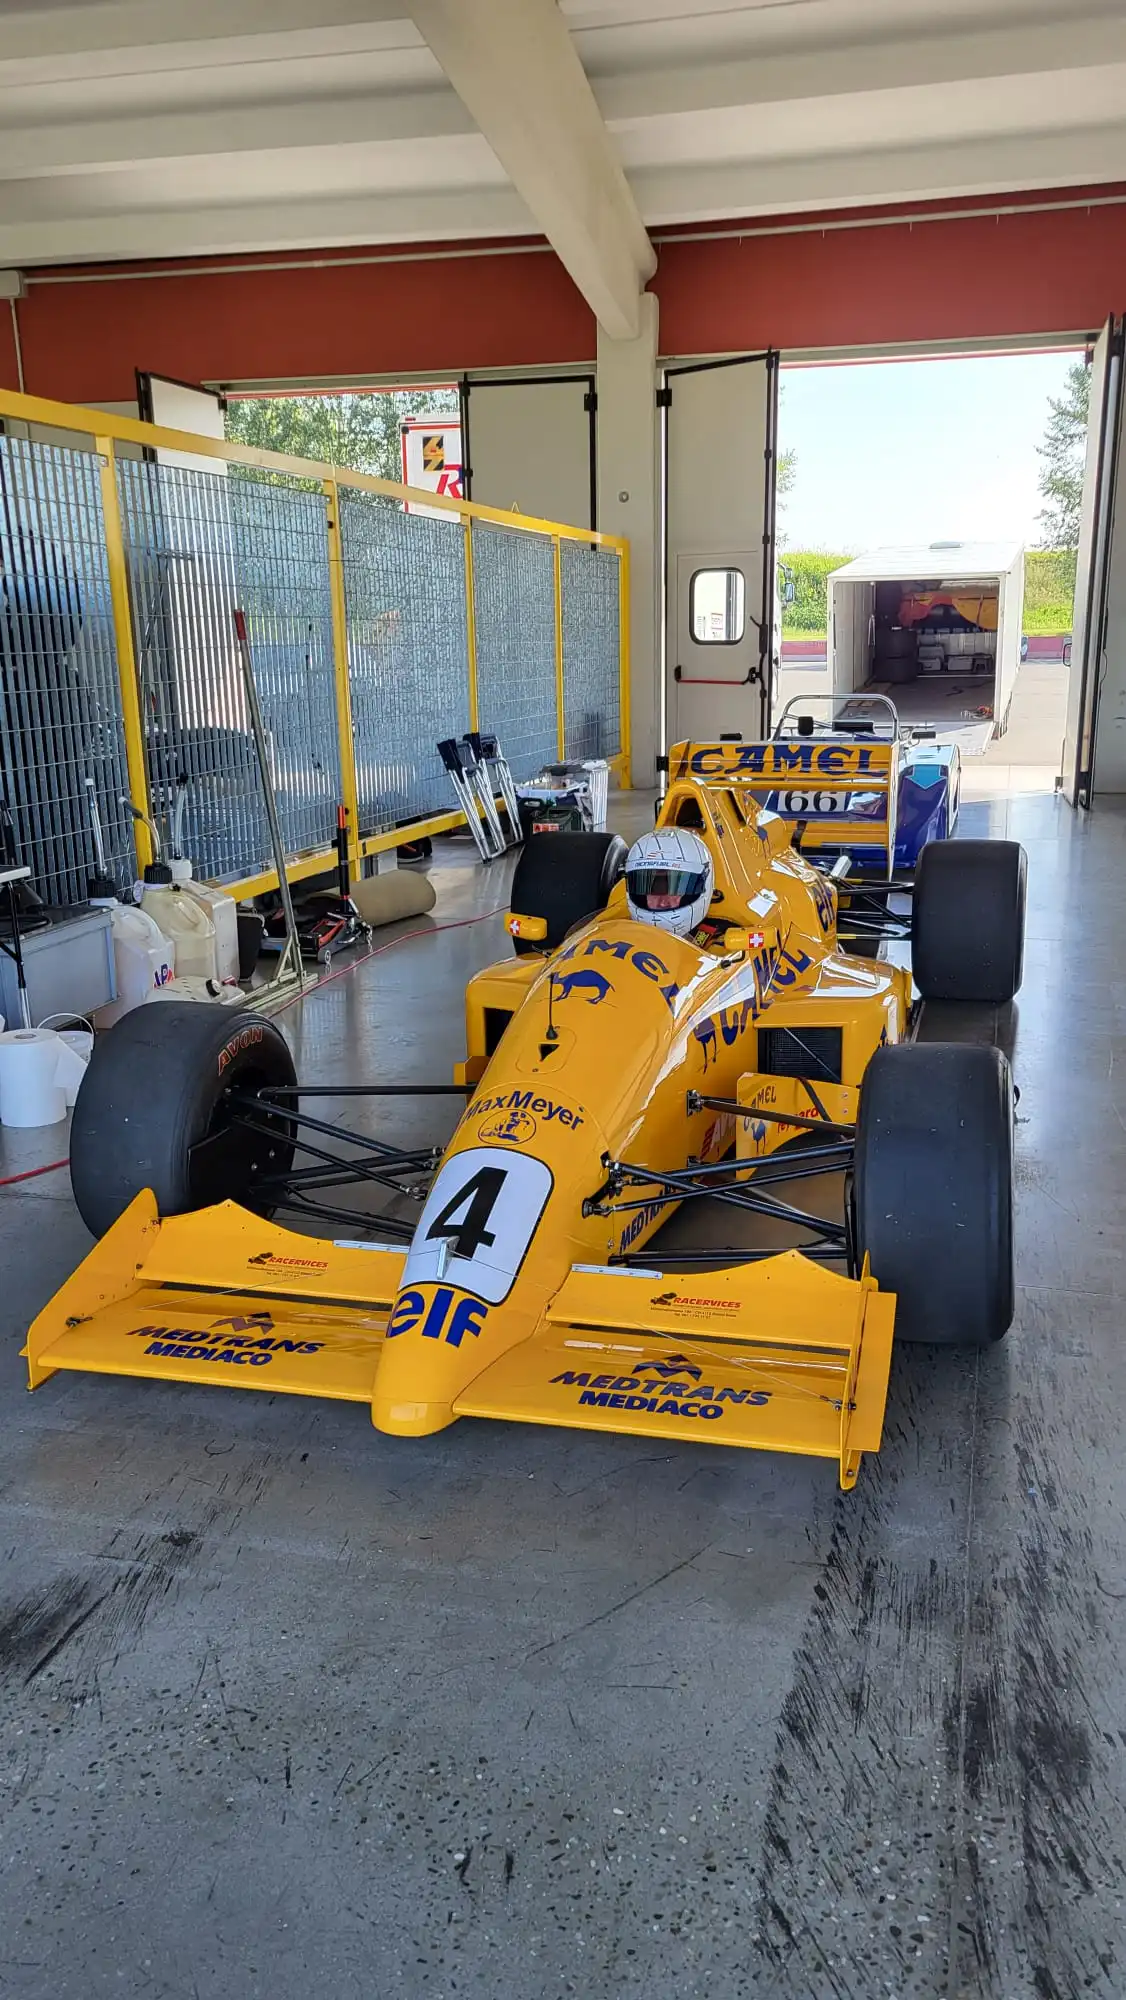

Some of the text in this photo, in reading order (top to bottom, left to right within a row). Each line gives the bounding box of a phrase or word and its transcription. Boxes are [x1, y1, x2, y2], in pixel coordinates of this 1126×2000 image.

[691, 745, 888, 777] CAMEL
[218, 1026, 263, 1076] AVON
[463, 1091, 585, 1131] MaxMeyer
[424, 1166, 509, 1262] 4
[269, 1256, 329, 1268] RACERVICES
[385, 1288, 489, 1348] elf
[673, 1297, 742, 1308] RACERVICES
[125, 1325, 326, 1354] MEDTRANS
[144, 1341, 273, 1366] MEDIACO
[548, 1371, 773, 1406] MEDTRANS
[578, 1391, 724, 1420] MEDIACO
